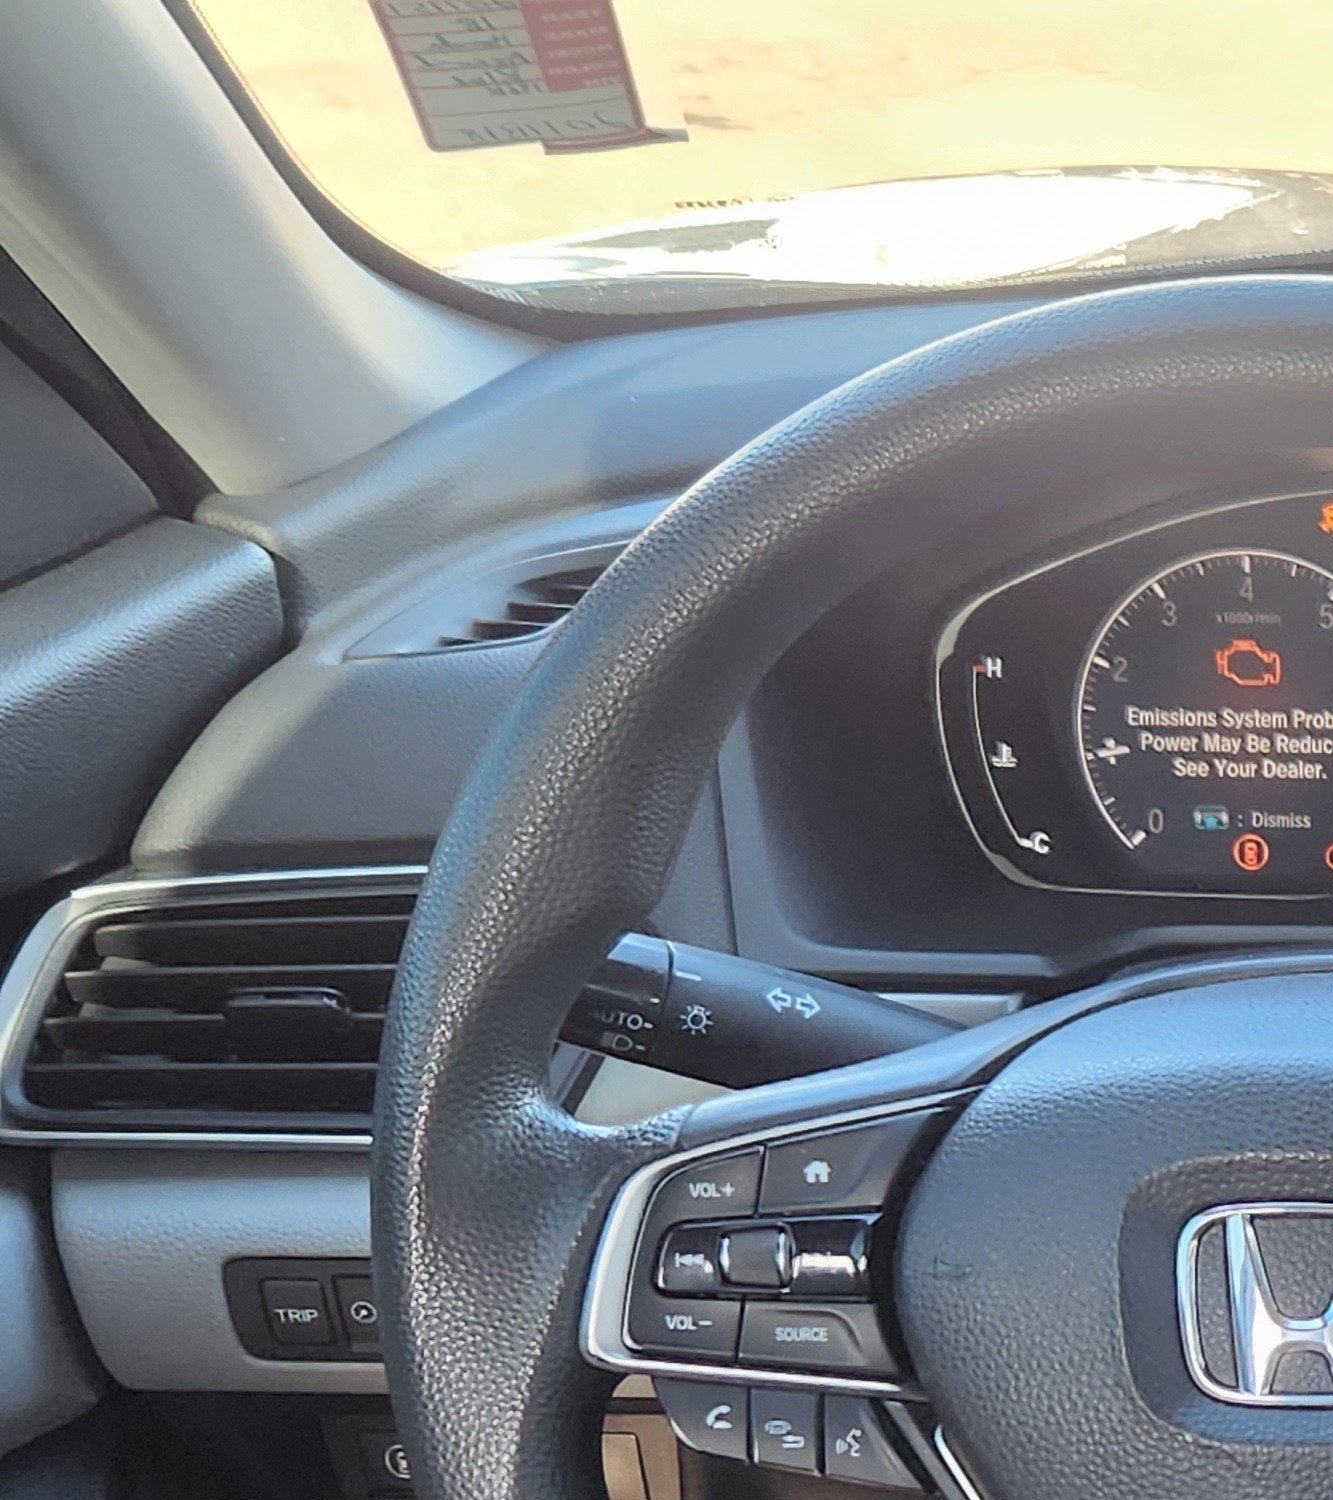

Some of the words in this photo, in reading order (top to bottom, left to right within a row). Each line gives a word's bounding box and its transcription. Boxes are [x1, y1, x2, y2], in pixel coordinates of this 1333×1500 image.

[1239, 577, 1254, 600] 4
[1162, 602, 1177, 627] 3
[1319, 603, 1333, 629] 5
[986, 657, 1003, 678] H
[1113, 657, 1128, 682] 2
[1126, 704, 1217, 728] Emissions
[1221, 707, 1288, 730] System
[1139, 730, 1199, 752] Power
[1203, 732, 1242, 755] May
[1246, 733, 1271, 754] Be
[1173, 757, 1209, 778] See
[1214, 758, 1258, 779] Your
[1261, 760, 1328, 781] Dealer.
[1149, 808, 1164, 833] 0
[1252, 812, 1312, 829] Dismiss
[274, 1308, 319, 1324] TRIP
[774, 1327, 829, 1342] SOURCE
